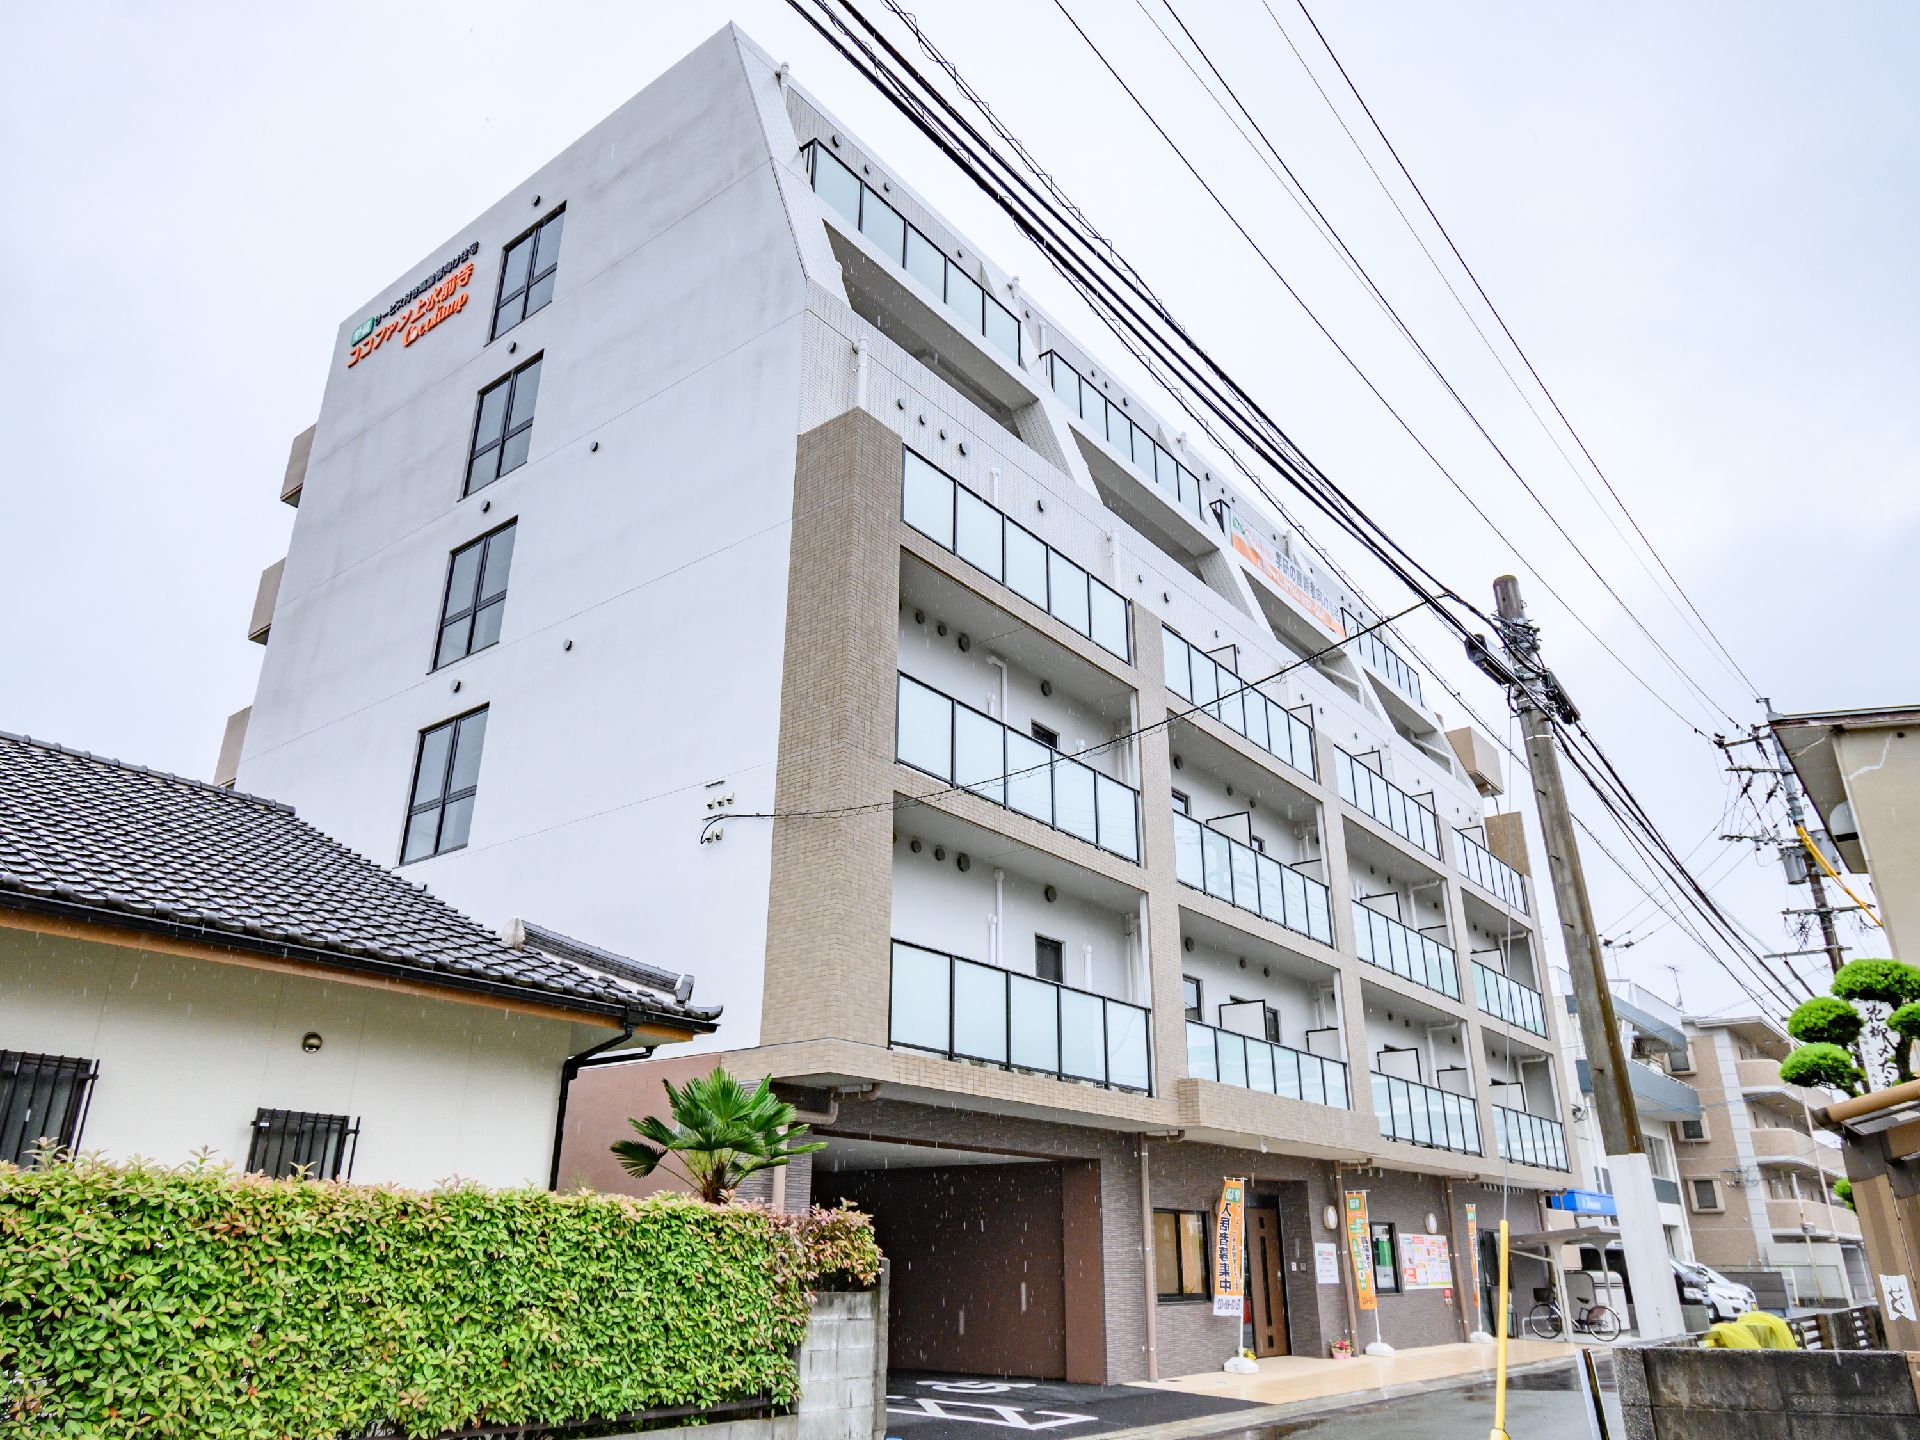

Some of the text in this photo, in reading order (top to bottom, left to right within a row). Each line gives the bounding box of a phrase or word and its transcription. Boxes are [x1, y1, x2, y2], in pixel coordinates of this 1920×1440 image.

[347, 262, 474, 370] ココファン上水前寺
